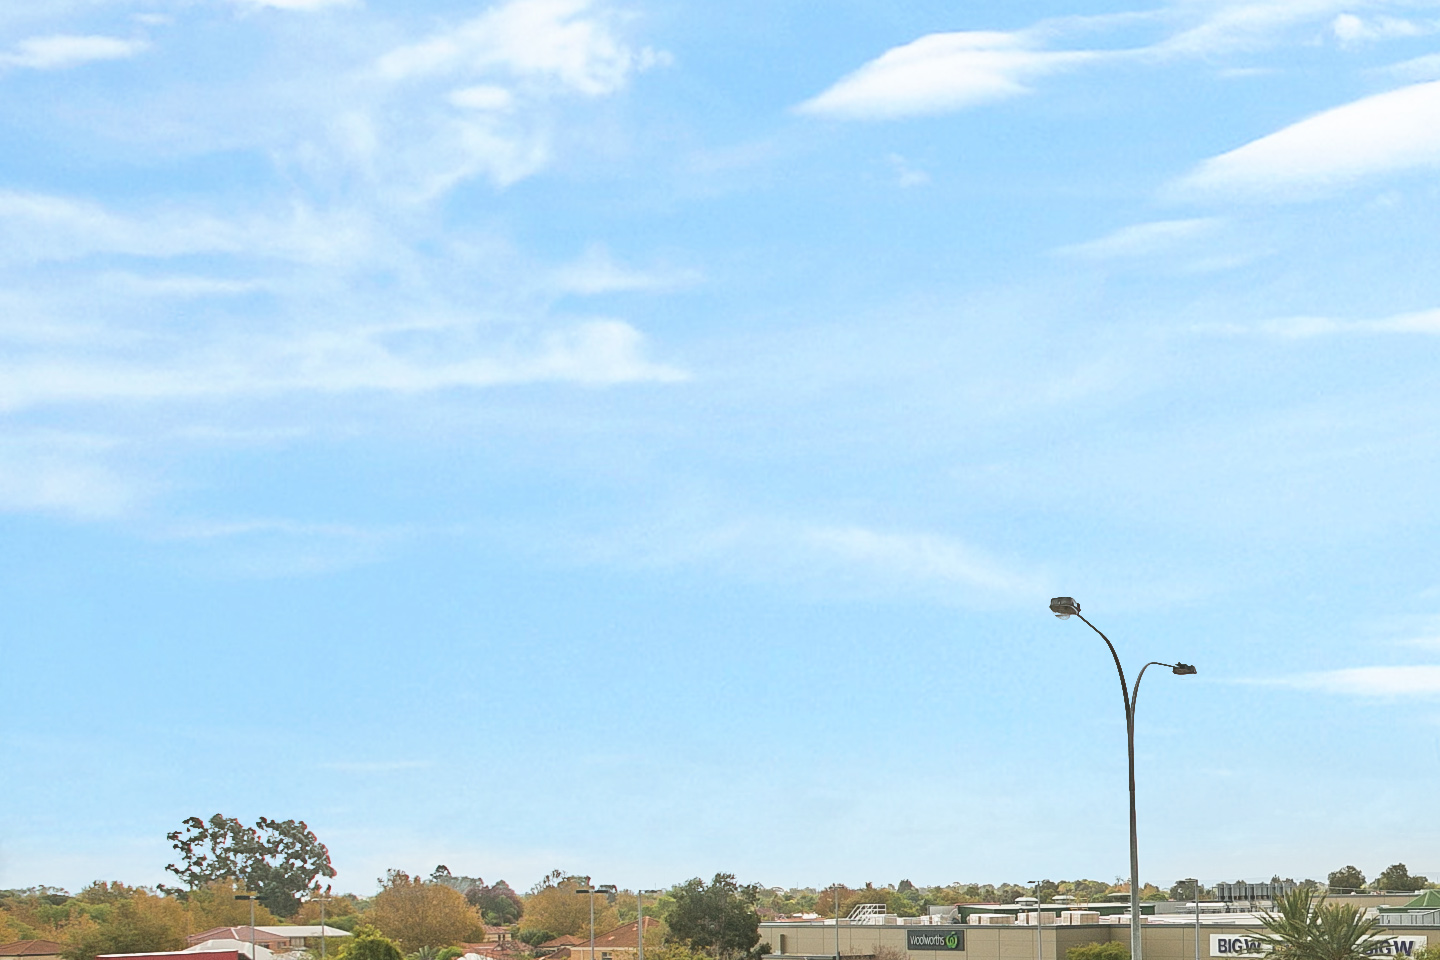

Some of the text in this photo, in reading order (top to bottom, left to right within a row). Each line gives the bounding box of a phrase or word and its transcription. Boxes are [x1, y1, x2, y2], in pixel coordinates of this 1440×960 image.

[910, 933, 945, 946] Woolworths
[1218, 938, 1243, 953] BIG
[1393, 940, 1414, 956] W
